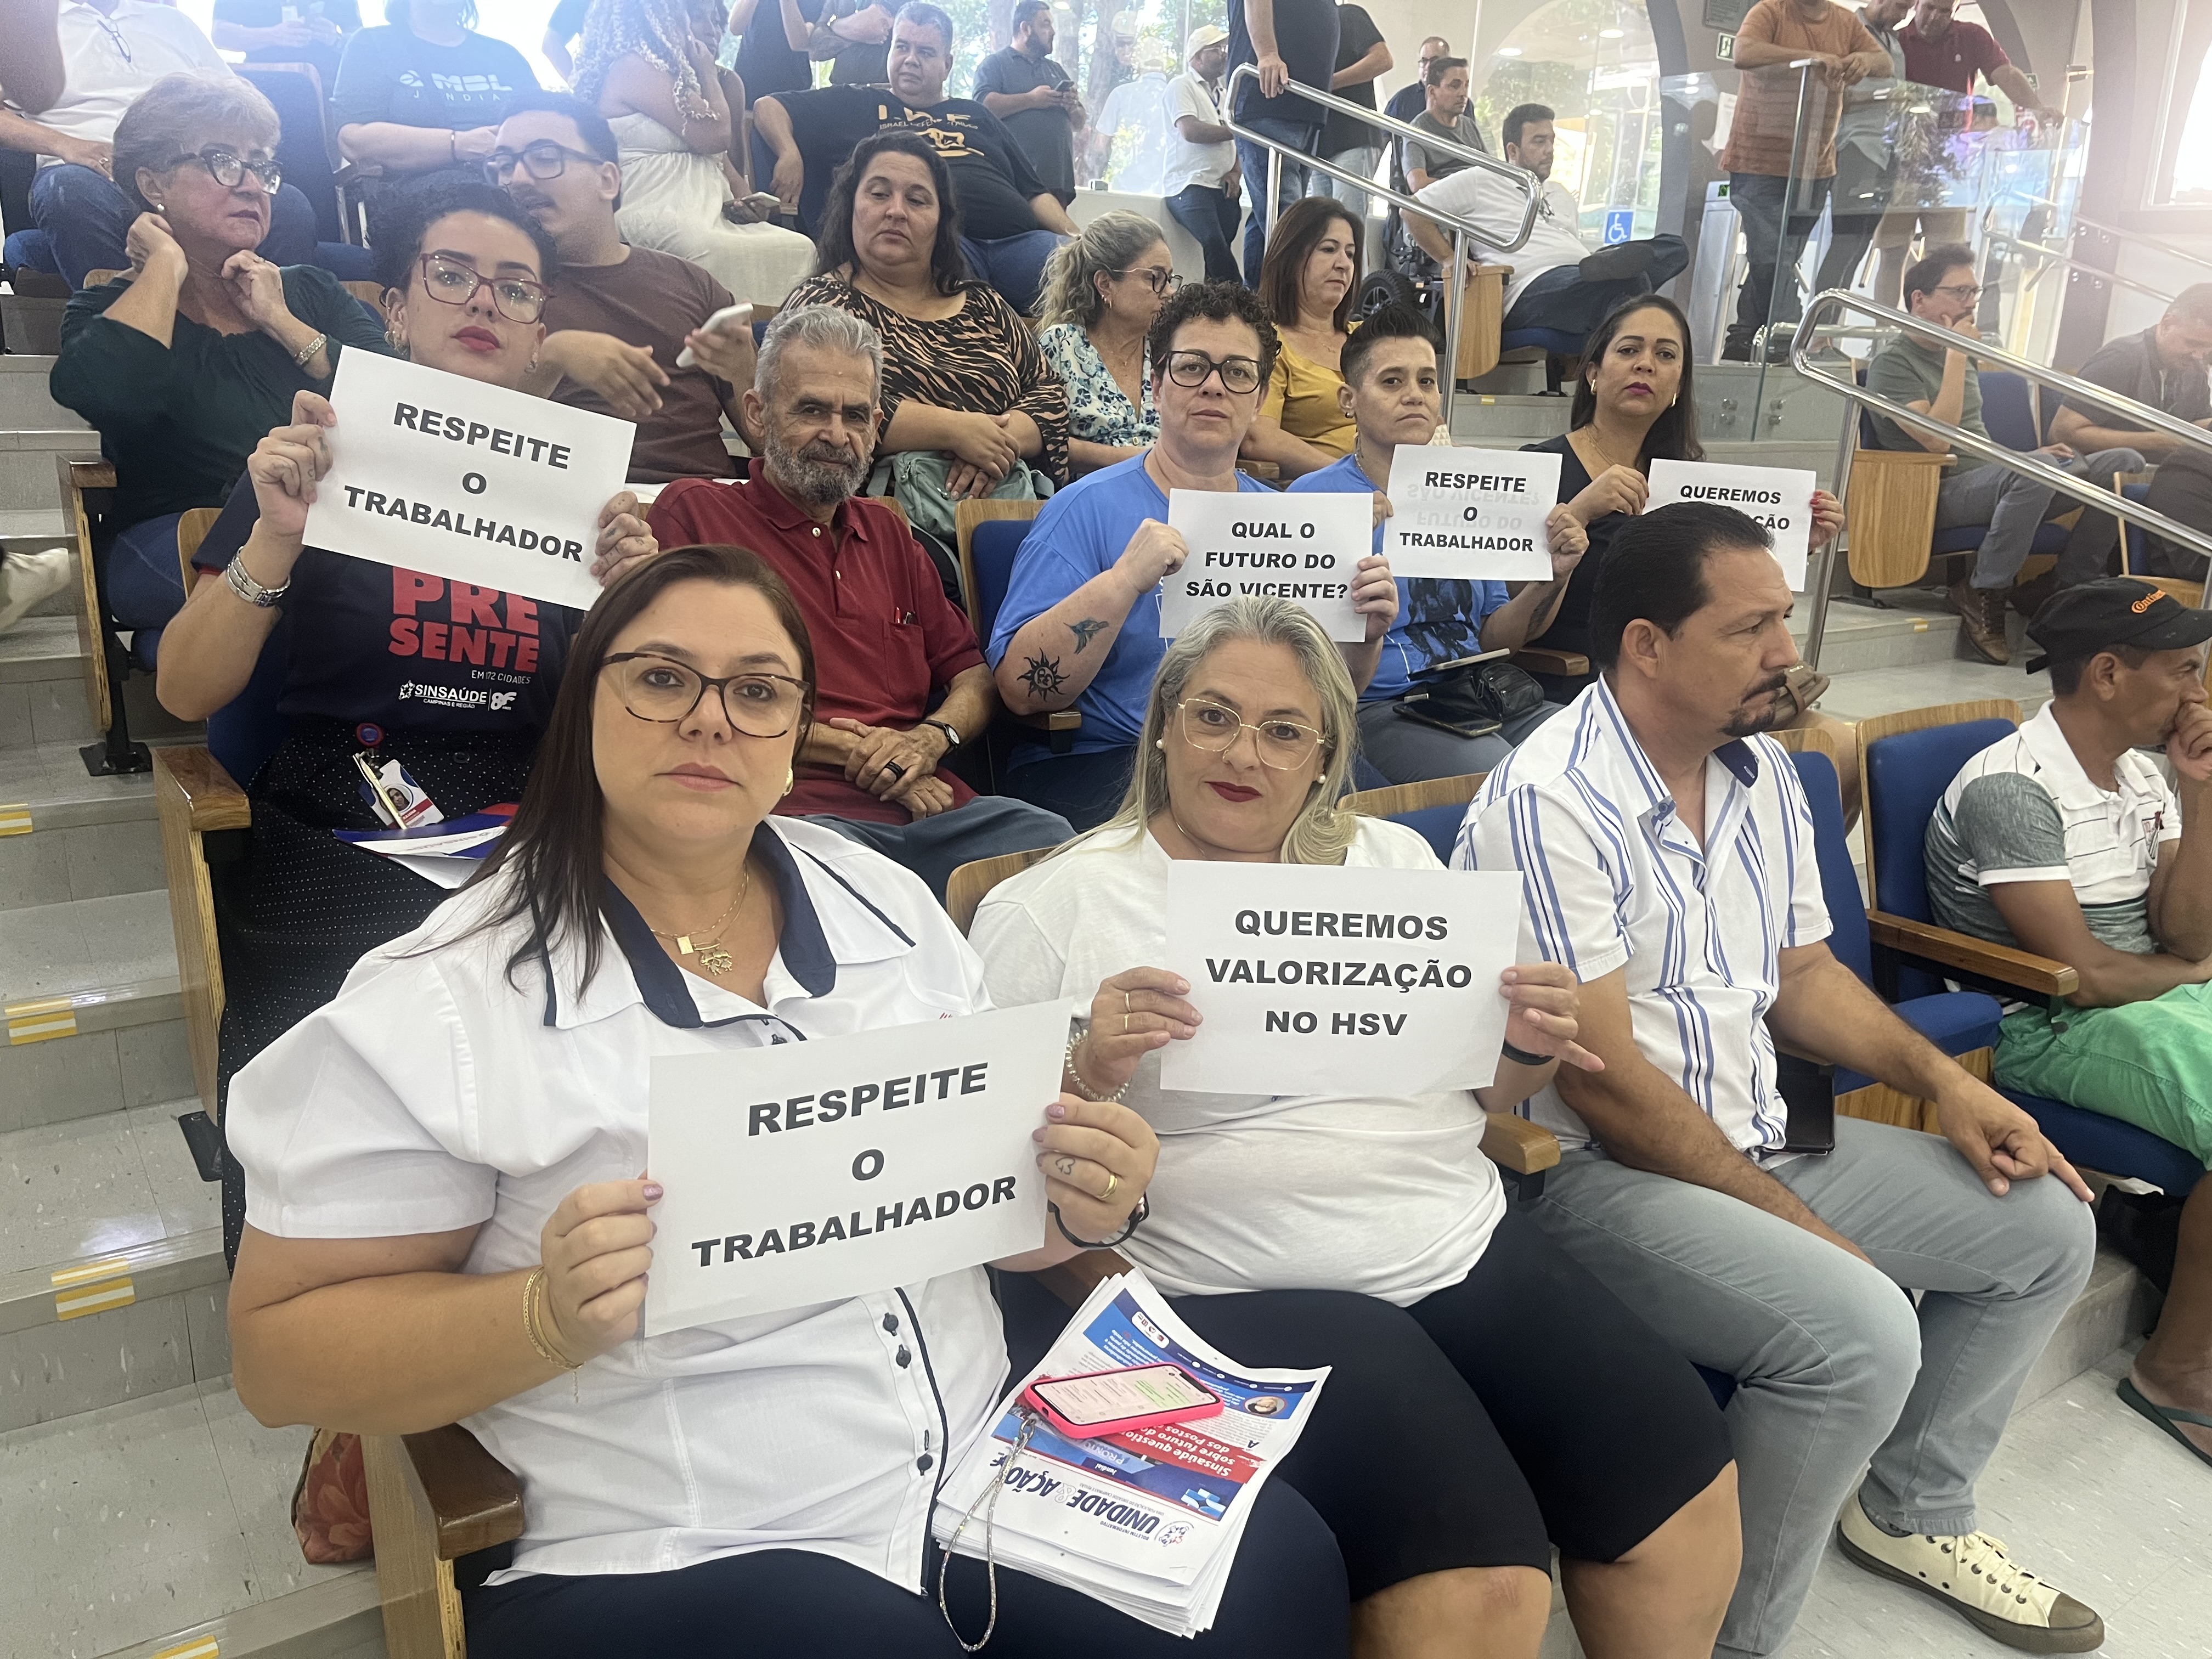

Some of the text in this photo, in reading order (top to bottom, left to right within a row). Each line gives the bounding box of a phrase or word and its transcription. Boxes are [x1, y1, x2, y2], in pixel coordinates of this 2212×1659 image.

[394, 402, 571, 469] RESPEITE
[462, 473, 486, 494] O
[1426, 472, 1526, 492] RESPEITE
[1680, 486, 1781, 504] QUEREMOS
[345, 486, 582, 562] TRABALHADOR
[1464, 507, 1477, 521] O
[1232, 522, 1314, 538] QUAL O
[1400, 533, 1532, 551] TRABALHADOR
[1206, 552, 1335, 569] FUTURO DO
[1186, 579, 1348, 599] SÃO VICENTE?
[388, 618, 539, 673] SENTE
[472, 670, 484, 680] EM
[498, 673, 531, 684] CIDADES
[415, 684, 488, 702] SINSAÚDE
[1235, 910, 1447, 940] QUEREMOS
[1206, 959, 1471, 992] VALORIZAÇÃO
[1266, 1011, 1407, 1035] NO HSV
[749, 1063, 988, 1136] RESPEITE
[853, 1149, 884, 1180] O
[692, 1176, 1015, 1267] TRABALHADOR
[1156, 1431, 1198, 1452] futuro
[1164, 1424, 1206, 1446] Postos
[1198, 1447, 1235, 1465] sobre
[1206, 1440, 1230, 1454] dos
[1172, 1448, 1232, 1477] Sinsaúde
[1066, 1488, 1160, 1534] UNIDADE
[1099, 1519, 1149, 1541] BOLETIM INFORMATIVO
